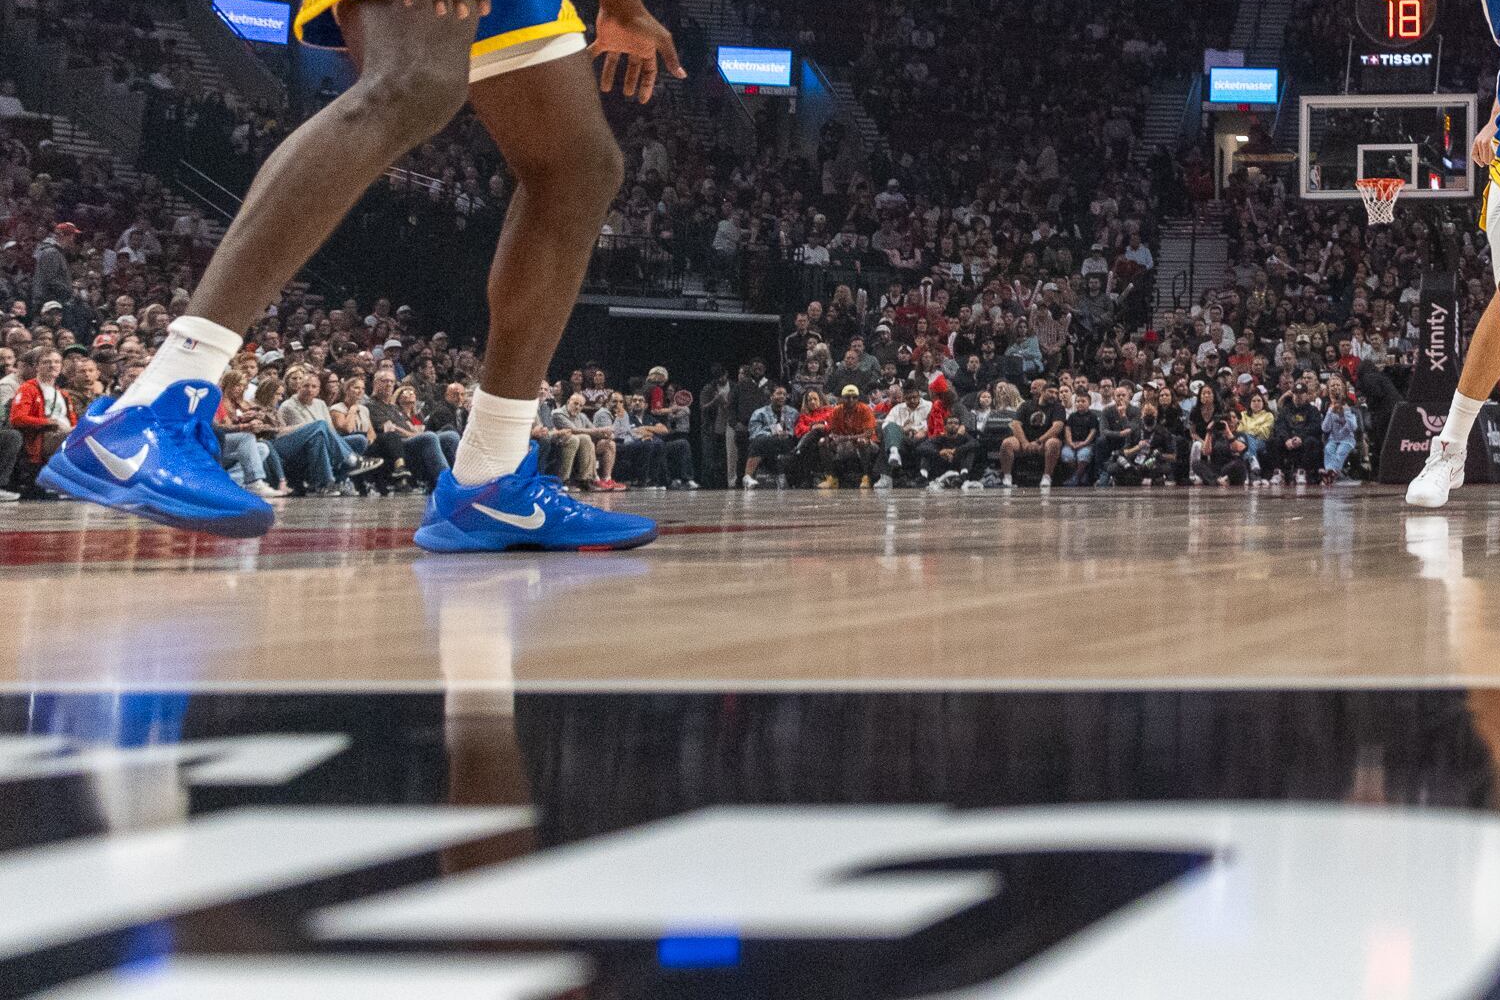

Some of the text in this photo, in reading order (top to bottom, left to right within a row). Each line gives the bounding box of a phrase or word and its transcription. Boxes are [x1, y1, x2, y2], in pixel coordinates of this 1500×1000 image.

[1388, 0, 1420, 38] 18
[721, 60, 786, 72] ticketmaster
[1380, 53, 1432, 66] TISSOT
[1214, 80, 1273, 91] ticketmaster
[1425, 302, 1449, 372] xfinity
[1400, 439, 1431, 452] Fred
